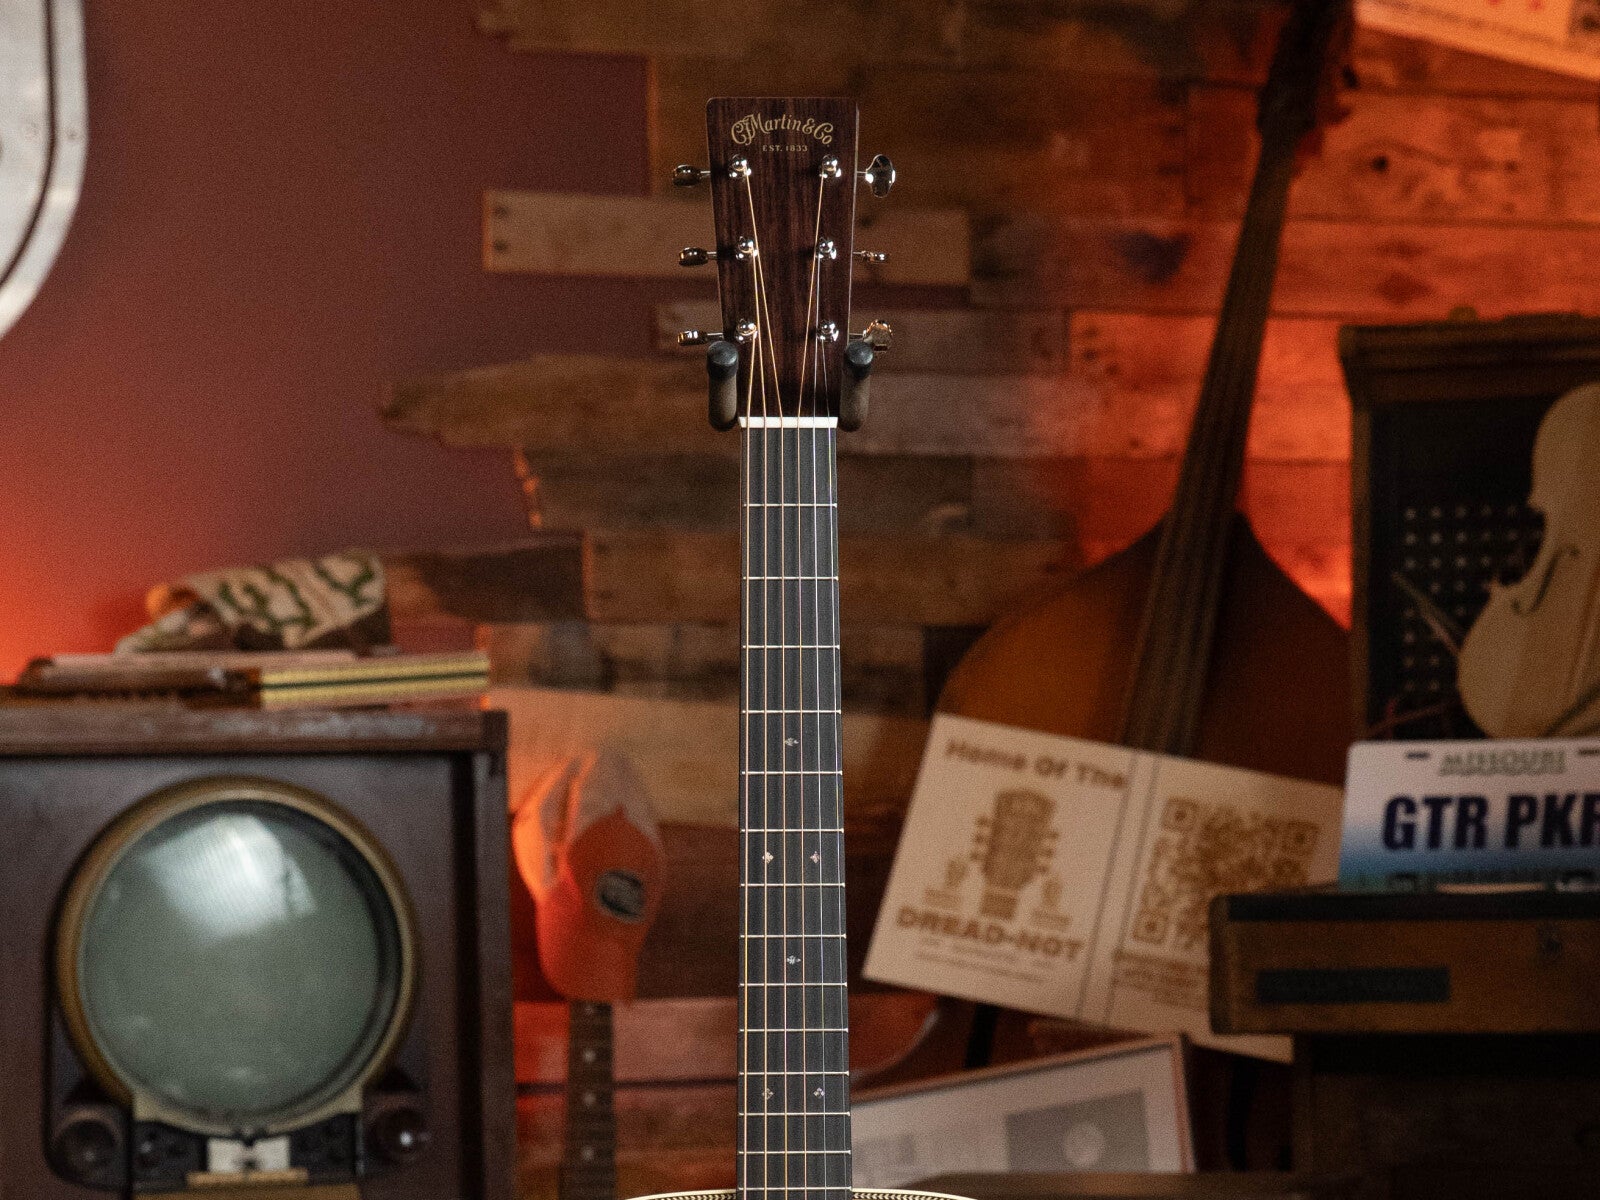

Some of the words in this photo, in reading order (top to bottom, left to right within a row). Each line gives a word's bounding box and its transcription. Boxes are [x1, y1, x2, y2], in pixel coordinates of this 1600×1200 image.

[945, 738, 1027, 773] Home
[1034, 757, 1067, 779] Of
[1076, 764, 1130, 789] The
[1383, 795, 1489, 850] GTR
[896, 905, 1085, 962] DREAD-NOT
